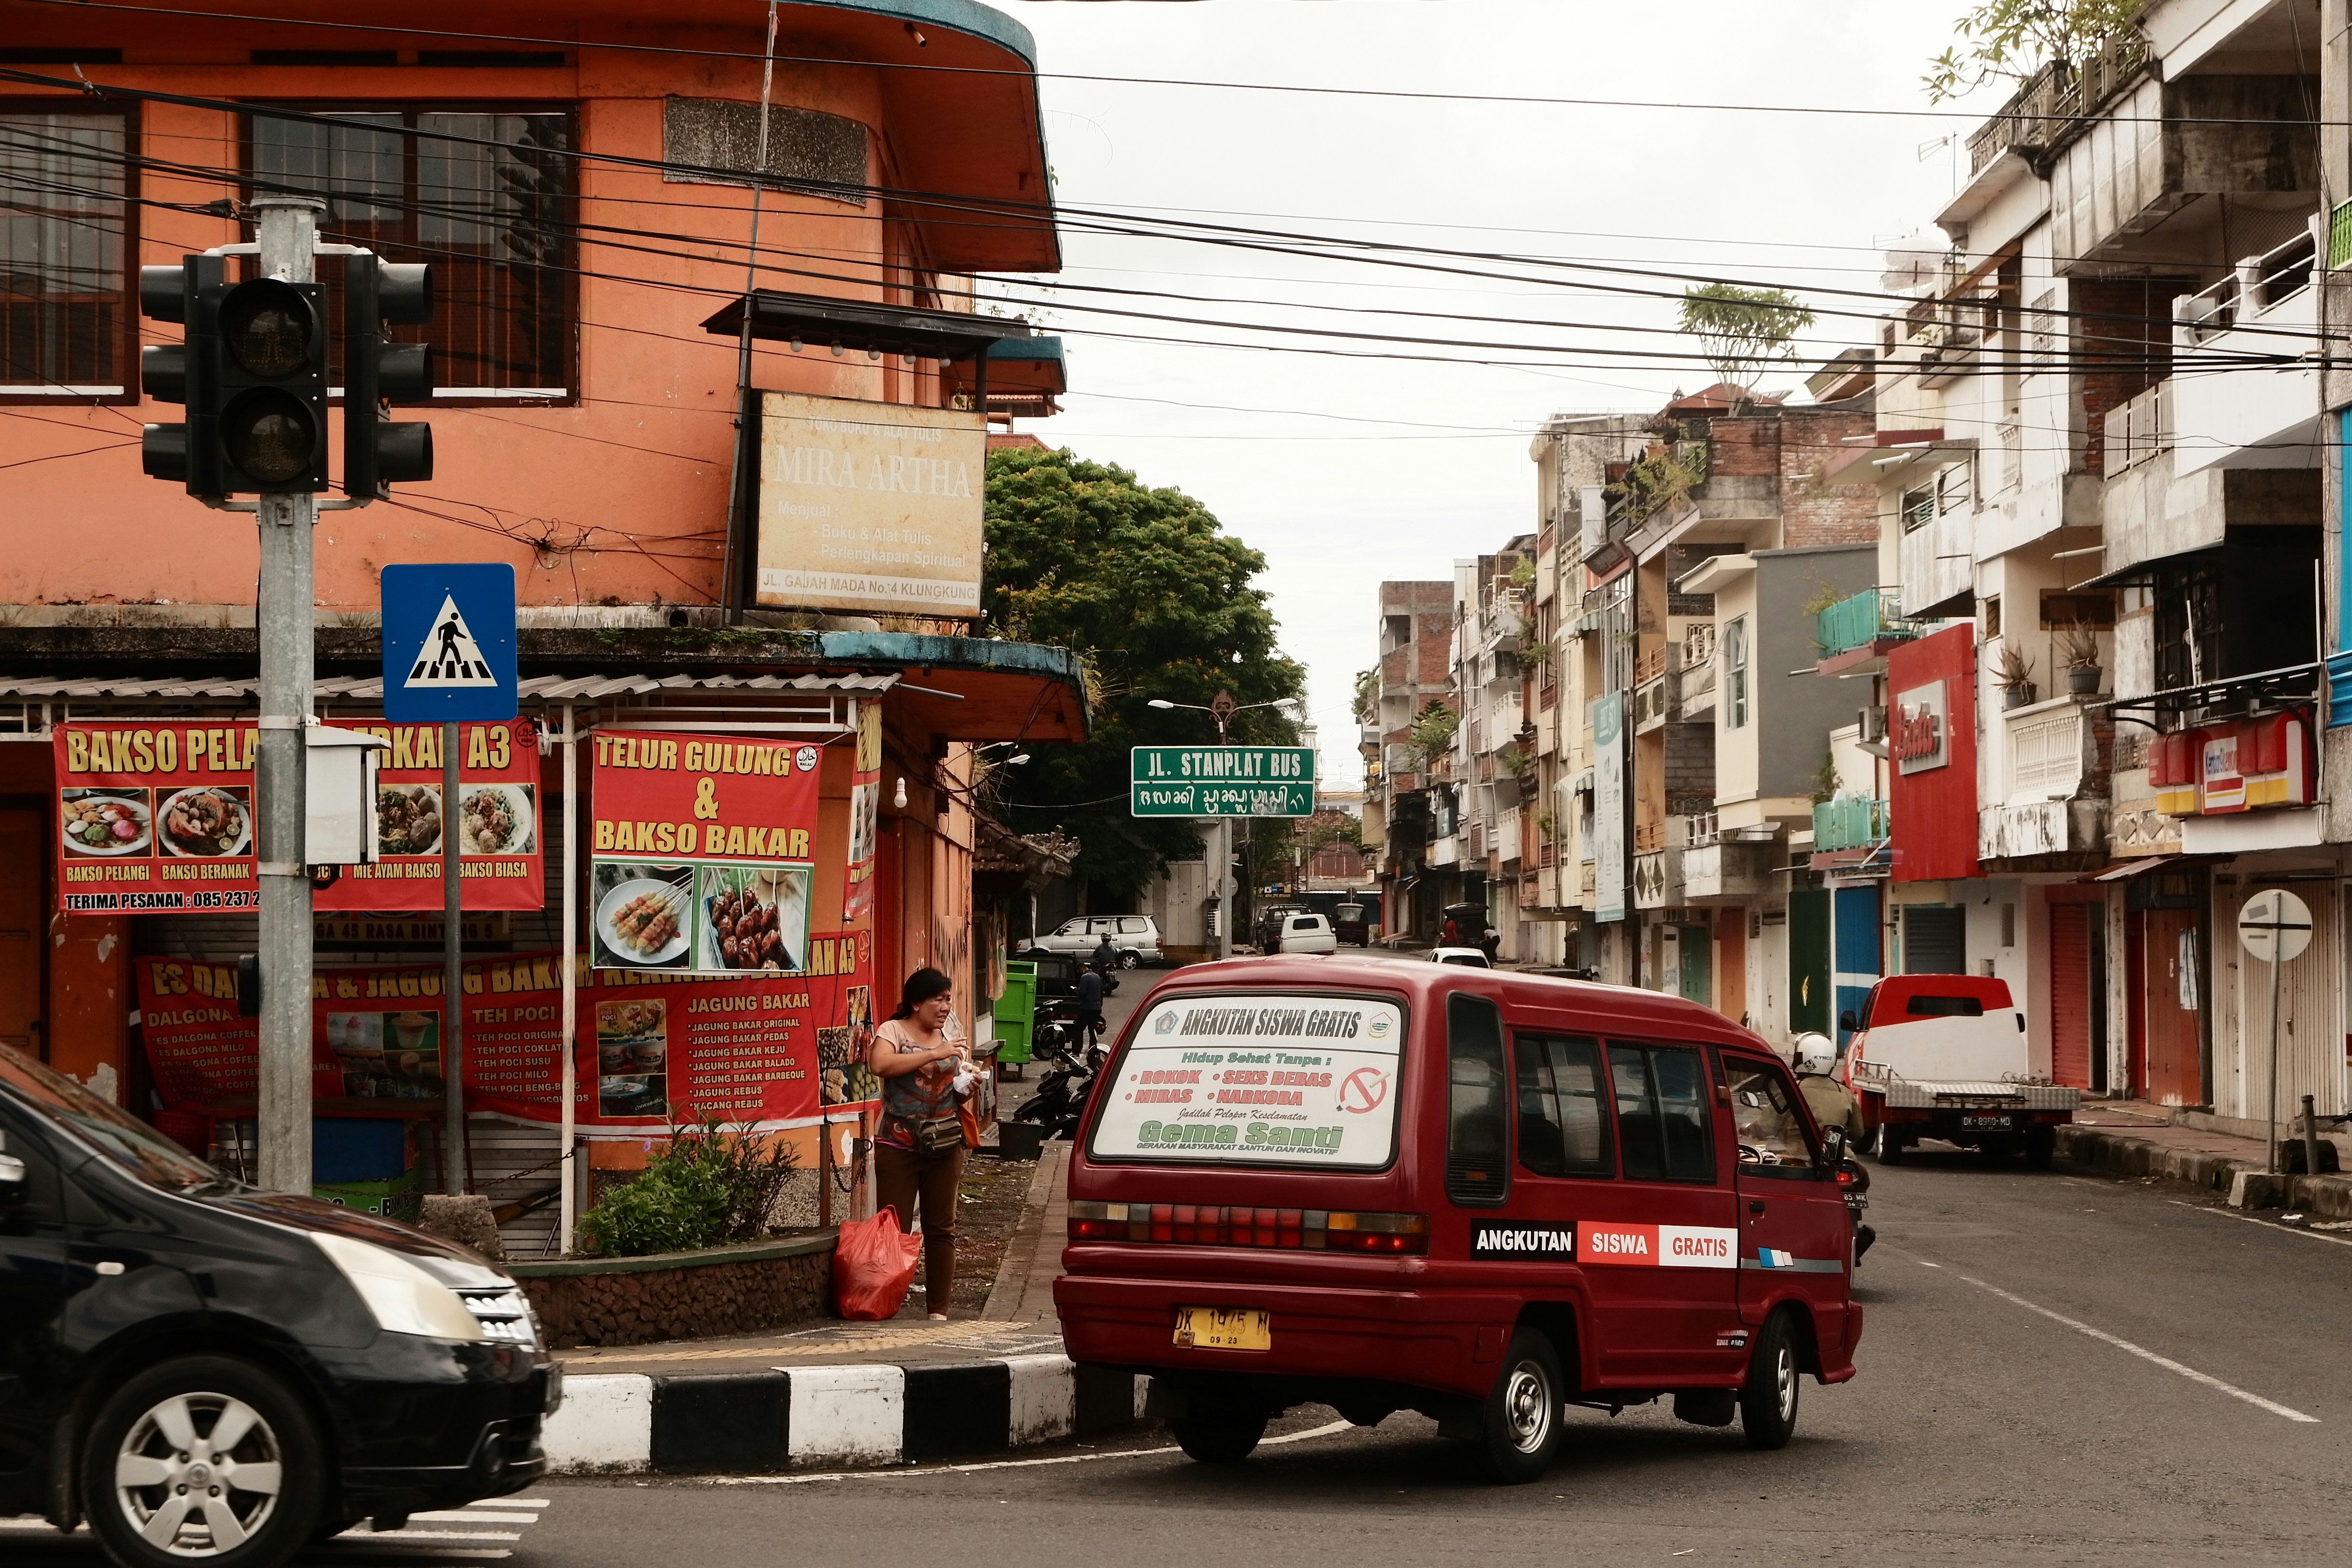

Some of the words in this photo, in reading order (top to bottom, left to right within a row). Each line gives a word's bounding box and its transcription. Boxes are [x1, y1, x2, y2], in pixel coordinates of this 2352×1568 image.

[774, 444, 858, 489] MIRA
[866, 453, 973, 499] ARTHA
[778, 500, 830, 520] Menjual
[822, 524, 856, 540] Buku
[860, 527, 870, 541] &
[872, 527, 899, 543] Alat
[902, 529, 932, 546] Tulis
[821, 543, 909, 565] Perlengkapan
[914, 551, 966, 569] Spiritual
[763, 574, 781, 587] JL.
[784, 575, 827, 590] GAJAH
[831, 578, 866, 593] MADA
[869, 581, 887, 594] No.
[891, 583, 897, 595] 4
[901, 583, 976, 600] KLUNGKUNG
[66, 729, 178, 772] BAKSO
[186, 728, 260, 772] PELA
[466, 725, 511, 769] A3
[596, 736, 678, 770] TELUR
[684, 740, 791, 776] GULUNG
[1148, 752, 1171, 777] JL.
[1181, 752, 1263, 777] STANPLAT
[1270, 753, 1300, 777] BUS
[693, 776, 719, 820] &
[595, 820, 698, 854] BAKSO
[705, 825, 810, 858] BAKAR
[66, 865, 103, 882] BAKSO
[105, 865, 150, 881] PELANGI
[162, 865, 198, 880] BAKSO
[200, 864, 250, 880] BERANAK
[353, 863, 372, 879] MIE
[374, 863, 403, 879] AYAM
[405, 863, 441, 879] BAKSO
[459, 862, 492, 878] BAKSO
[495, 862, 527, 878] BIASA
[65, 893, 118, 909] TERIMA
[121, 893, 184, 908] PESANAN
[194, 892, 220, 907] 085
[224, 891, 252, 906] 237
[342, 923, 359, 938] 45
[366, 923, 404, 939] RASA
[485, 922, 493, 938] 5
[838, 937, 856, 974] A3
[151, 962, 189, 995] ES
[337, 974, 359, 999] &
[366, 963, 483, 999] JAGUG
[687, 995, 758, 1013] JAGUNG
[762, 993, 810, 1010] BAKAR
[148, 1008, 234, 1027] DALGONA
[472, 1008, 508, 1024] TEH
[514, 1006, 556, 1022] POCI
[733, 1021, 762, 1030] BAKAR
[763, 1018, 800, 1029] ORIGINAL
[1180, 1009, 1258, 1036] ANGKUTAN
[1255, 1009, 1307, 1036] SISWA
[1305, 1009, 1362, 1039] GRATIS
[172, 1033, 217, 1043] DALGONA
[220, 1030, 257, 1039] COFFEE
[498, 1032, 520, 1041] POCI
[524, 1030, 563, 1040] ORIGINA
[733, 1034, 762, 1043] BAKAR
[764, 1032, 789, 1041] PEDAS
[173, 1045, 219, 1056] DALGONA
[221, 1043, 245, 1052] MILO
[525, 1043, 563, 1053] COKLAT
[733, 1047, 762, 1056] BAKAR
[765, 1045, 785, 1055] KEJU
[223, 1055, 259, 1064] COFFEE
[500, 1058, 522, 1066] POCI
[526, 1057, 551, 1066] SUSU
[734, 1061, 763, 1070] BAKAR
[765, 1058, 795, 1067] BALADO
[1182, 1052, 1224, 1066] Hidup
[1227, 1052, 1272, 1064] Sehat
[1275, 1053, 1322, 1067] Tanpa
[500, 1071, 522, 1079] POCI
[526, 1070, 548, 1079] MILO
[734, 1073, 763, 1083] BAKAR
[765, 1070, 805, 1081] BARBEQUE
[1139, 1070, 1202, 1084] ROKOK
[1222, 1070, 1269, 1085] SEKS
[1271, 1071, 1333, 1087] BEBAS
[501, 1084, 522, 1092] POCI
[526, 1082, 580, 1092] BENG-BG
[734, 1086, 762, 1096] REBUS
[735, 1099, 763, 1109] REBUS
[1134, 1089, 1193, 1103] MIRAS
[1216, 1089, 1303, 1106] NARKOBA
[1176, 1108, 1213, 1121] Jadilah
[1213, 1108, 1247, 1121] Pelopor
[1250, 1110, 1308, 1121] Keselamatan
[1963, 1117, 1973, 1126] DK
[1139, 1120, 1238, 1144] Gema
[1245, 1122, 1344, 1149] Santi
[1297, 1147, 1339, 1155] INOVATIF
[1476, 1230, 1572, 1251] ANGKUTAN
[1592, 1232, 1648, 1254] SISWA
[1672, 1237, 1727, 1257] GRATIS
